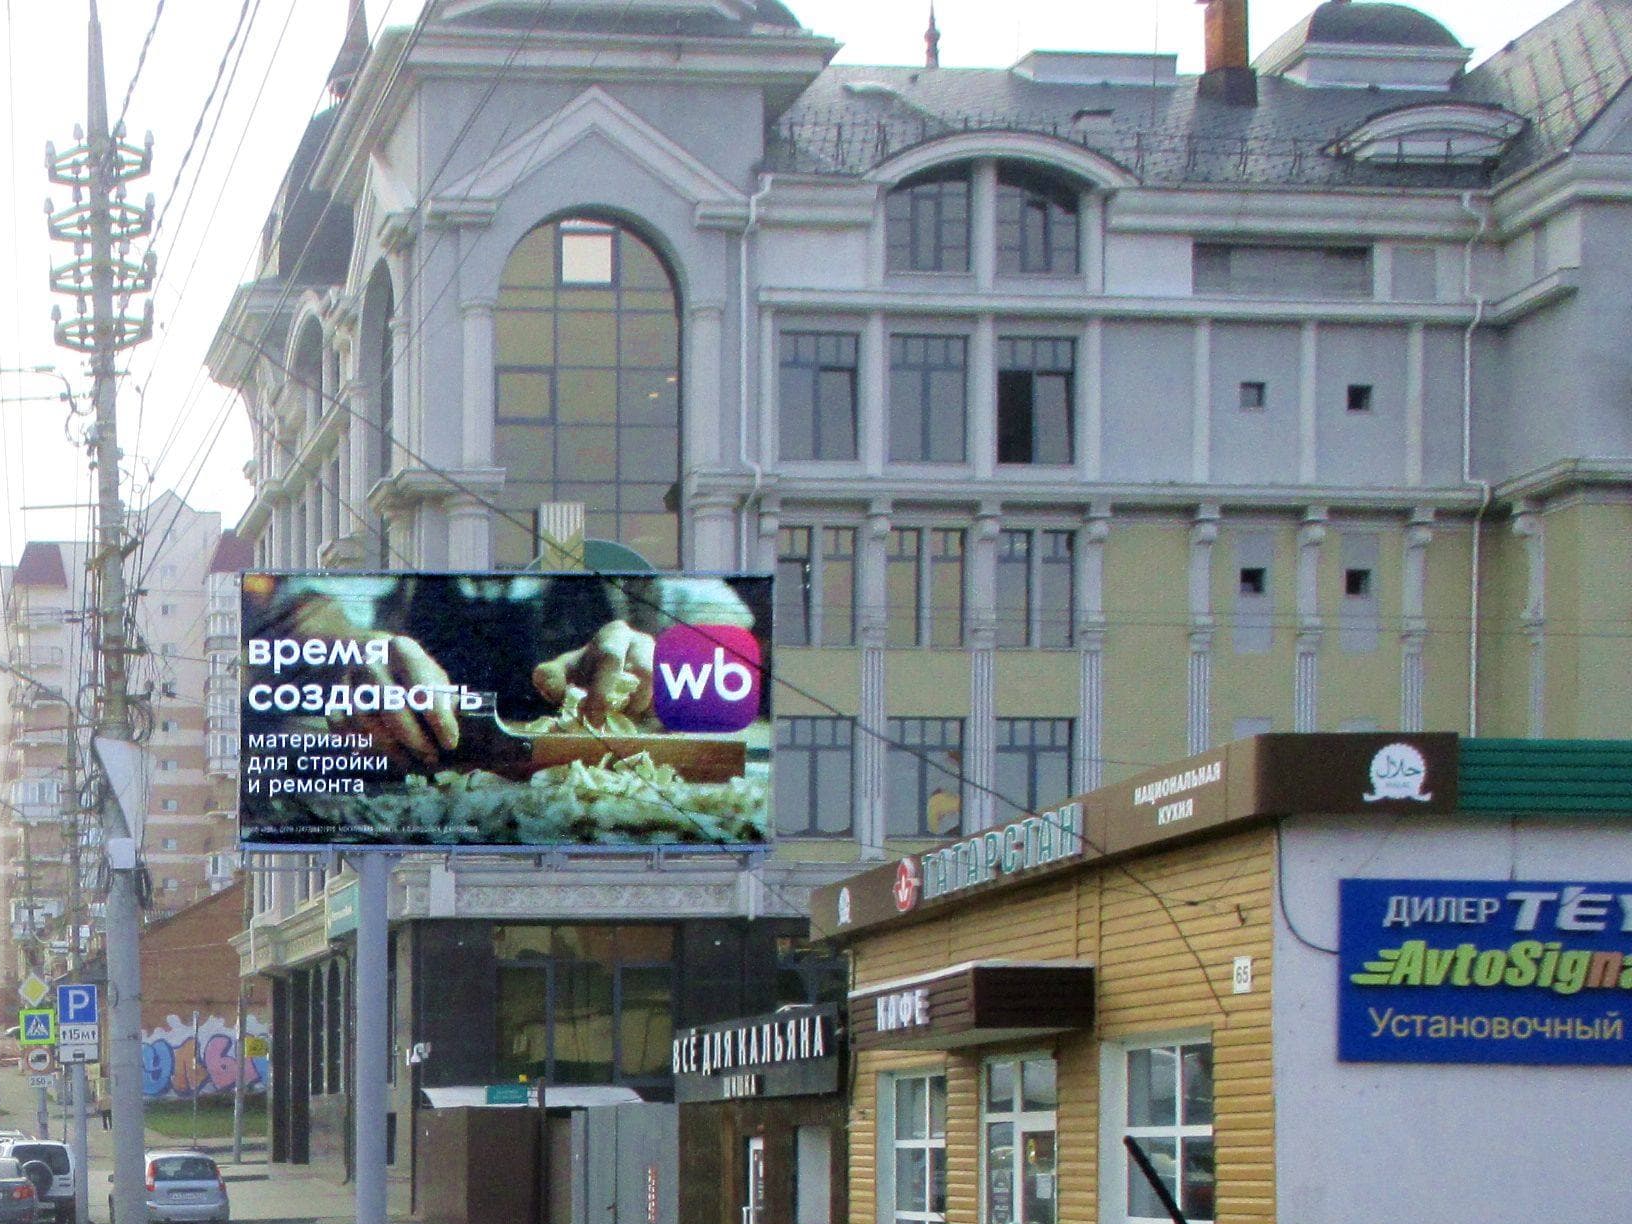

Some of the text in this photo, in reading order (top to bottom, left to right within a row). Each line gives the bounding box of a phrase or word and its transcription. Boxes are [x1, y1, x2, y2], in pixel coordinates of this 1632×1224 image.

[249, 637, 389, 674] время
[659, 647, 753, 702] wb
[248, 683, 483, 716] создавать
[248, 732, 373, 752] материалы
[247, 752, 388, 775] для стройки
[248, 777, 365, 797] и ремонта
[1134, 761, 1221, 806] НАЦИОНАЛЬНАЯ
[1157, 798, 1194, 825] КУХНЯ
[922, 802, 1083, 900] ТАТАРСТАН
[1382, 895, 1500, 928] ДИЛЕР
[1235, 965, 1250, 985] 65
[69, 989, 90, 1020] P
[876, 988, 930, 1032] КАФЕ
[1369, 1006, 1625, 1041] Установочный
[672, 1014, 824, 1076] ВСЁ ДЛЯ КАЛЬЯНА
